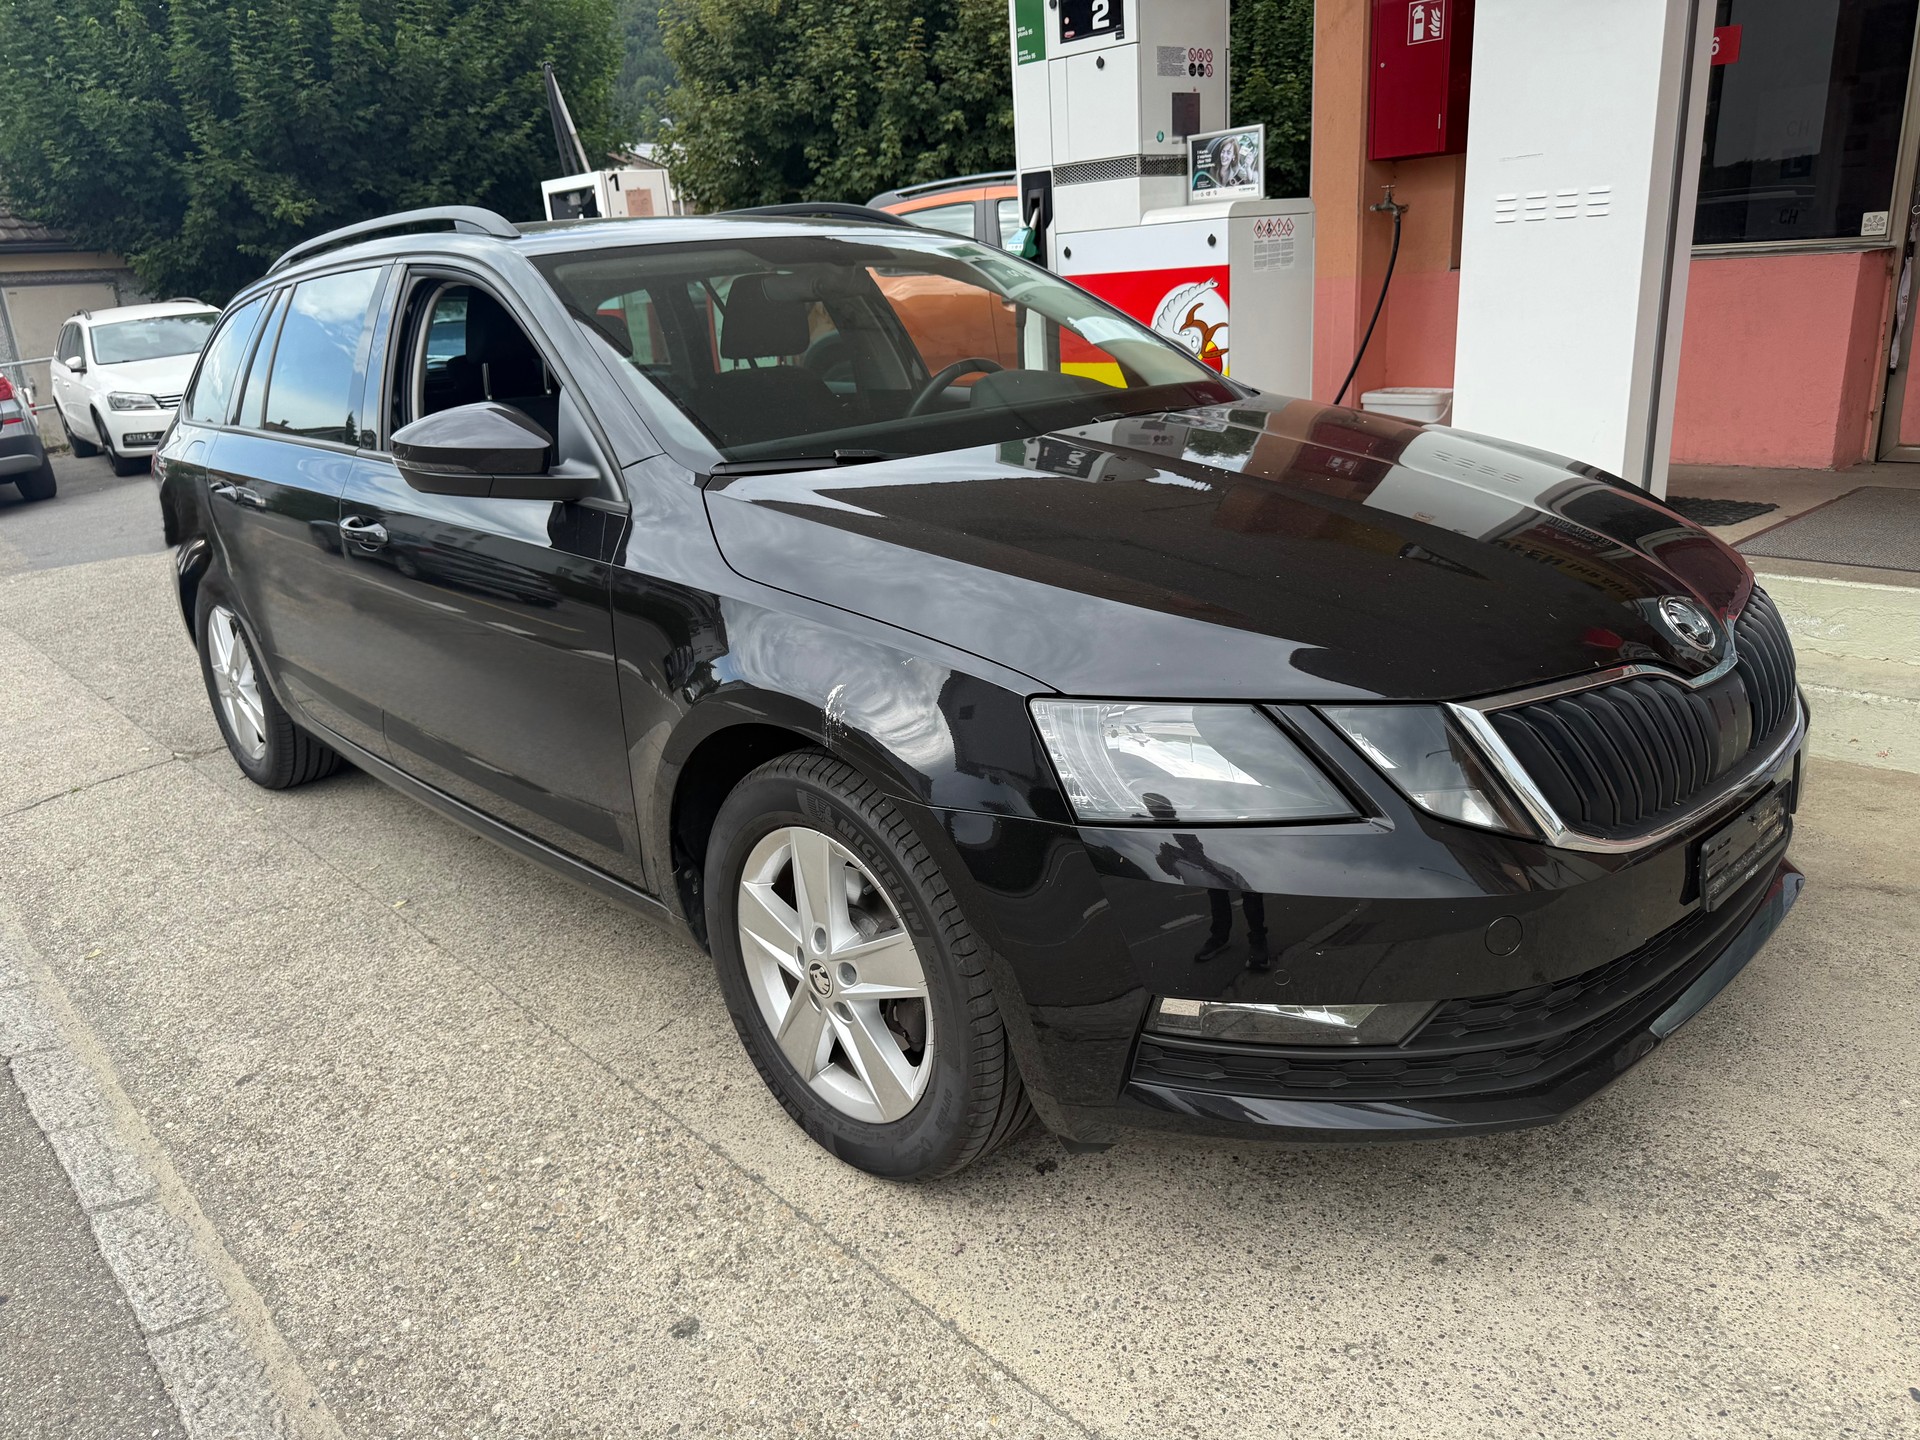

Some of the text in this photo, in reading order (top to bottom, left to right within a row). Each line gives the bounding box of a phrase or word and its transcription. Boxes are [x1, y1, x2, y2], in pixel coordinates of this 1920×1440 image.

[1091, 0, 1110, 30] 2
[1710, 36, 1720, 56] 6
[608, 173, 620, 191] 1
[1779, 208, 1799, 225] CH
[837, 818, 925, 931] MICHELIN
